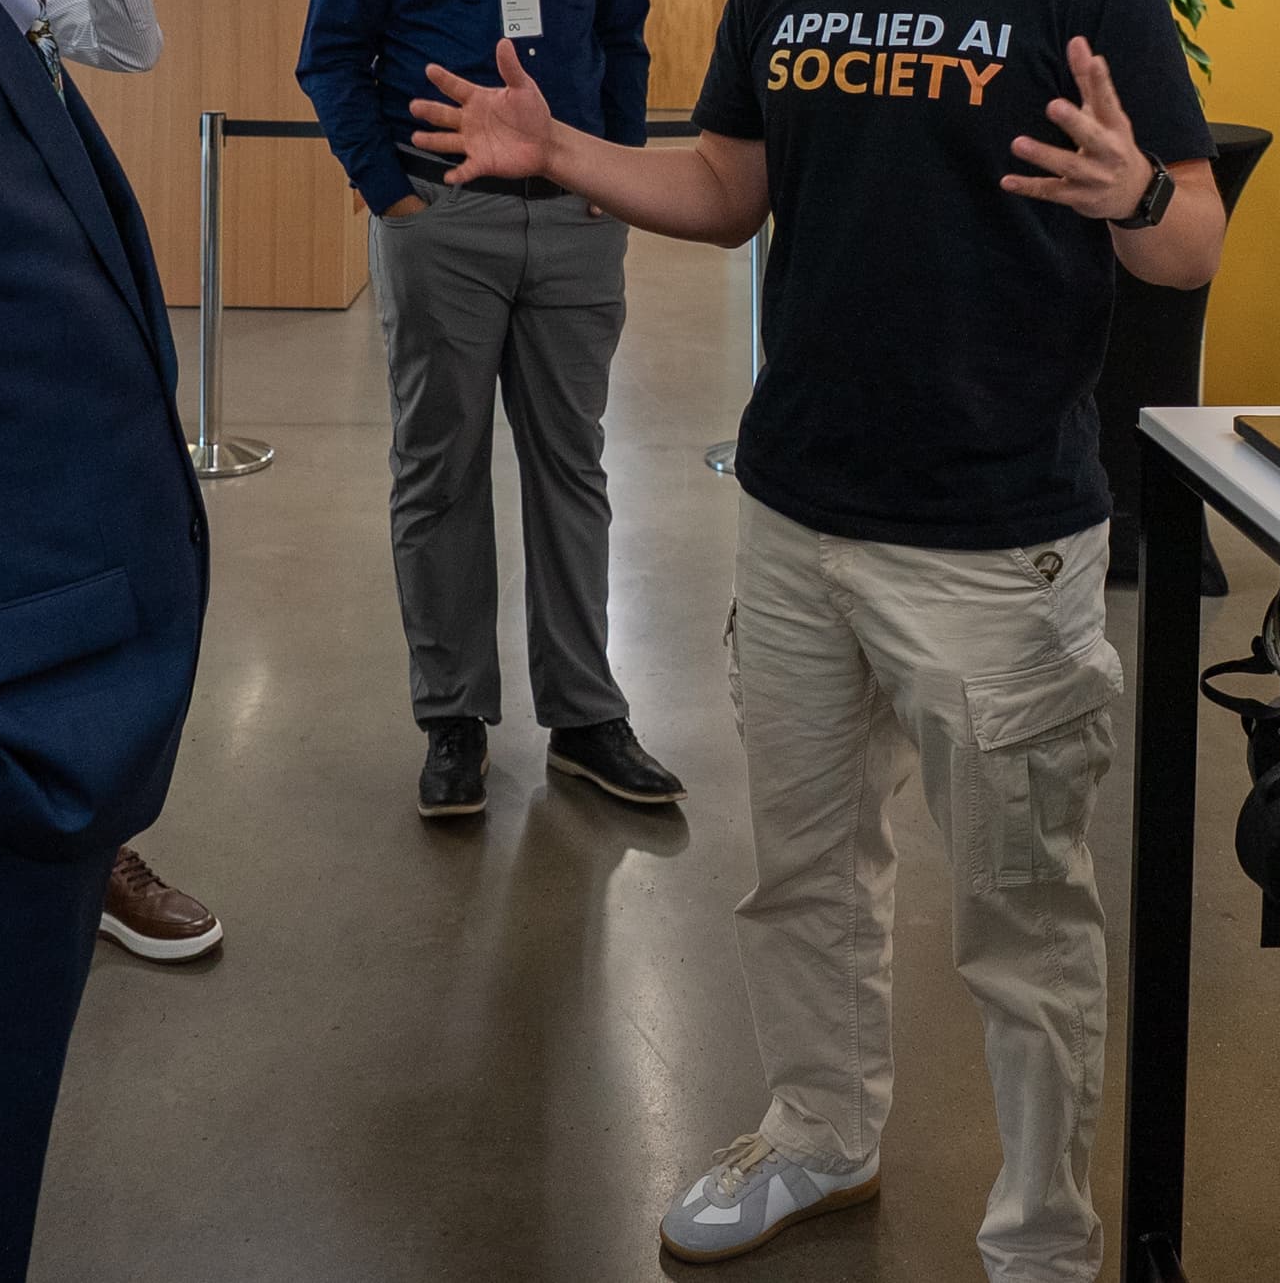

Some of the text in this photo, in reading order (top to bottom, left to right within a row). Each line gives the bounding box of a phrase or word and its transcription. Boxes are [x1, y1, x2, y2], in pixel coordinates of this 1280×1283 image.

[771, 12, 1012, 58] APPLIED AI
[767, 48, 1004, 106] SOCIETY
